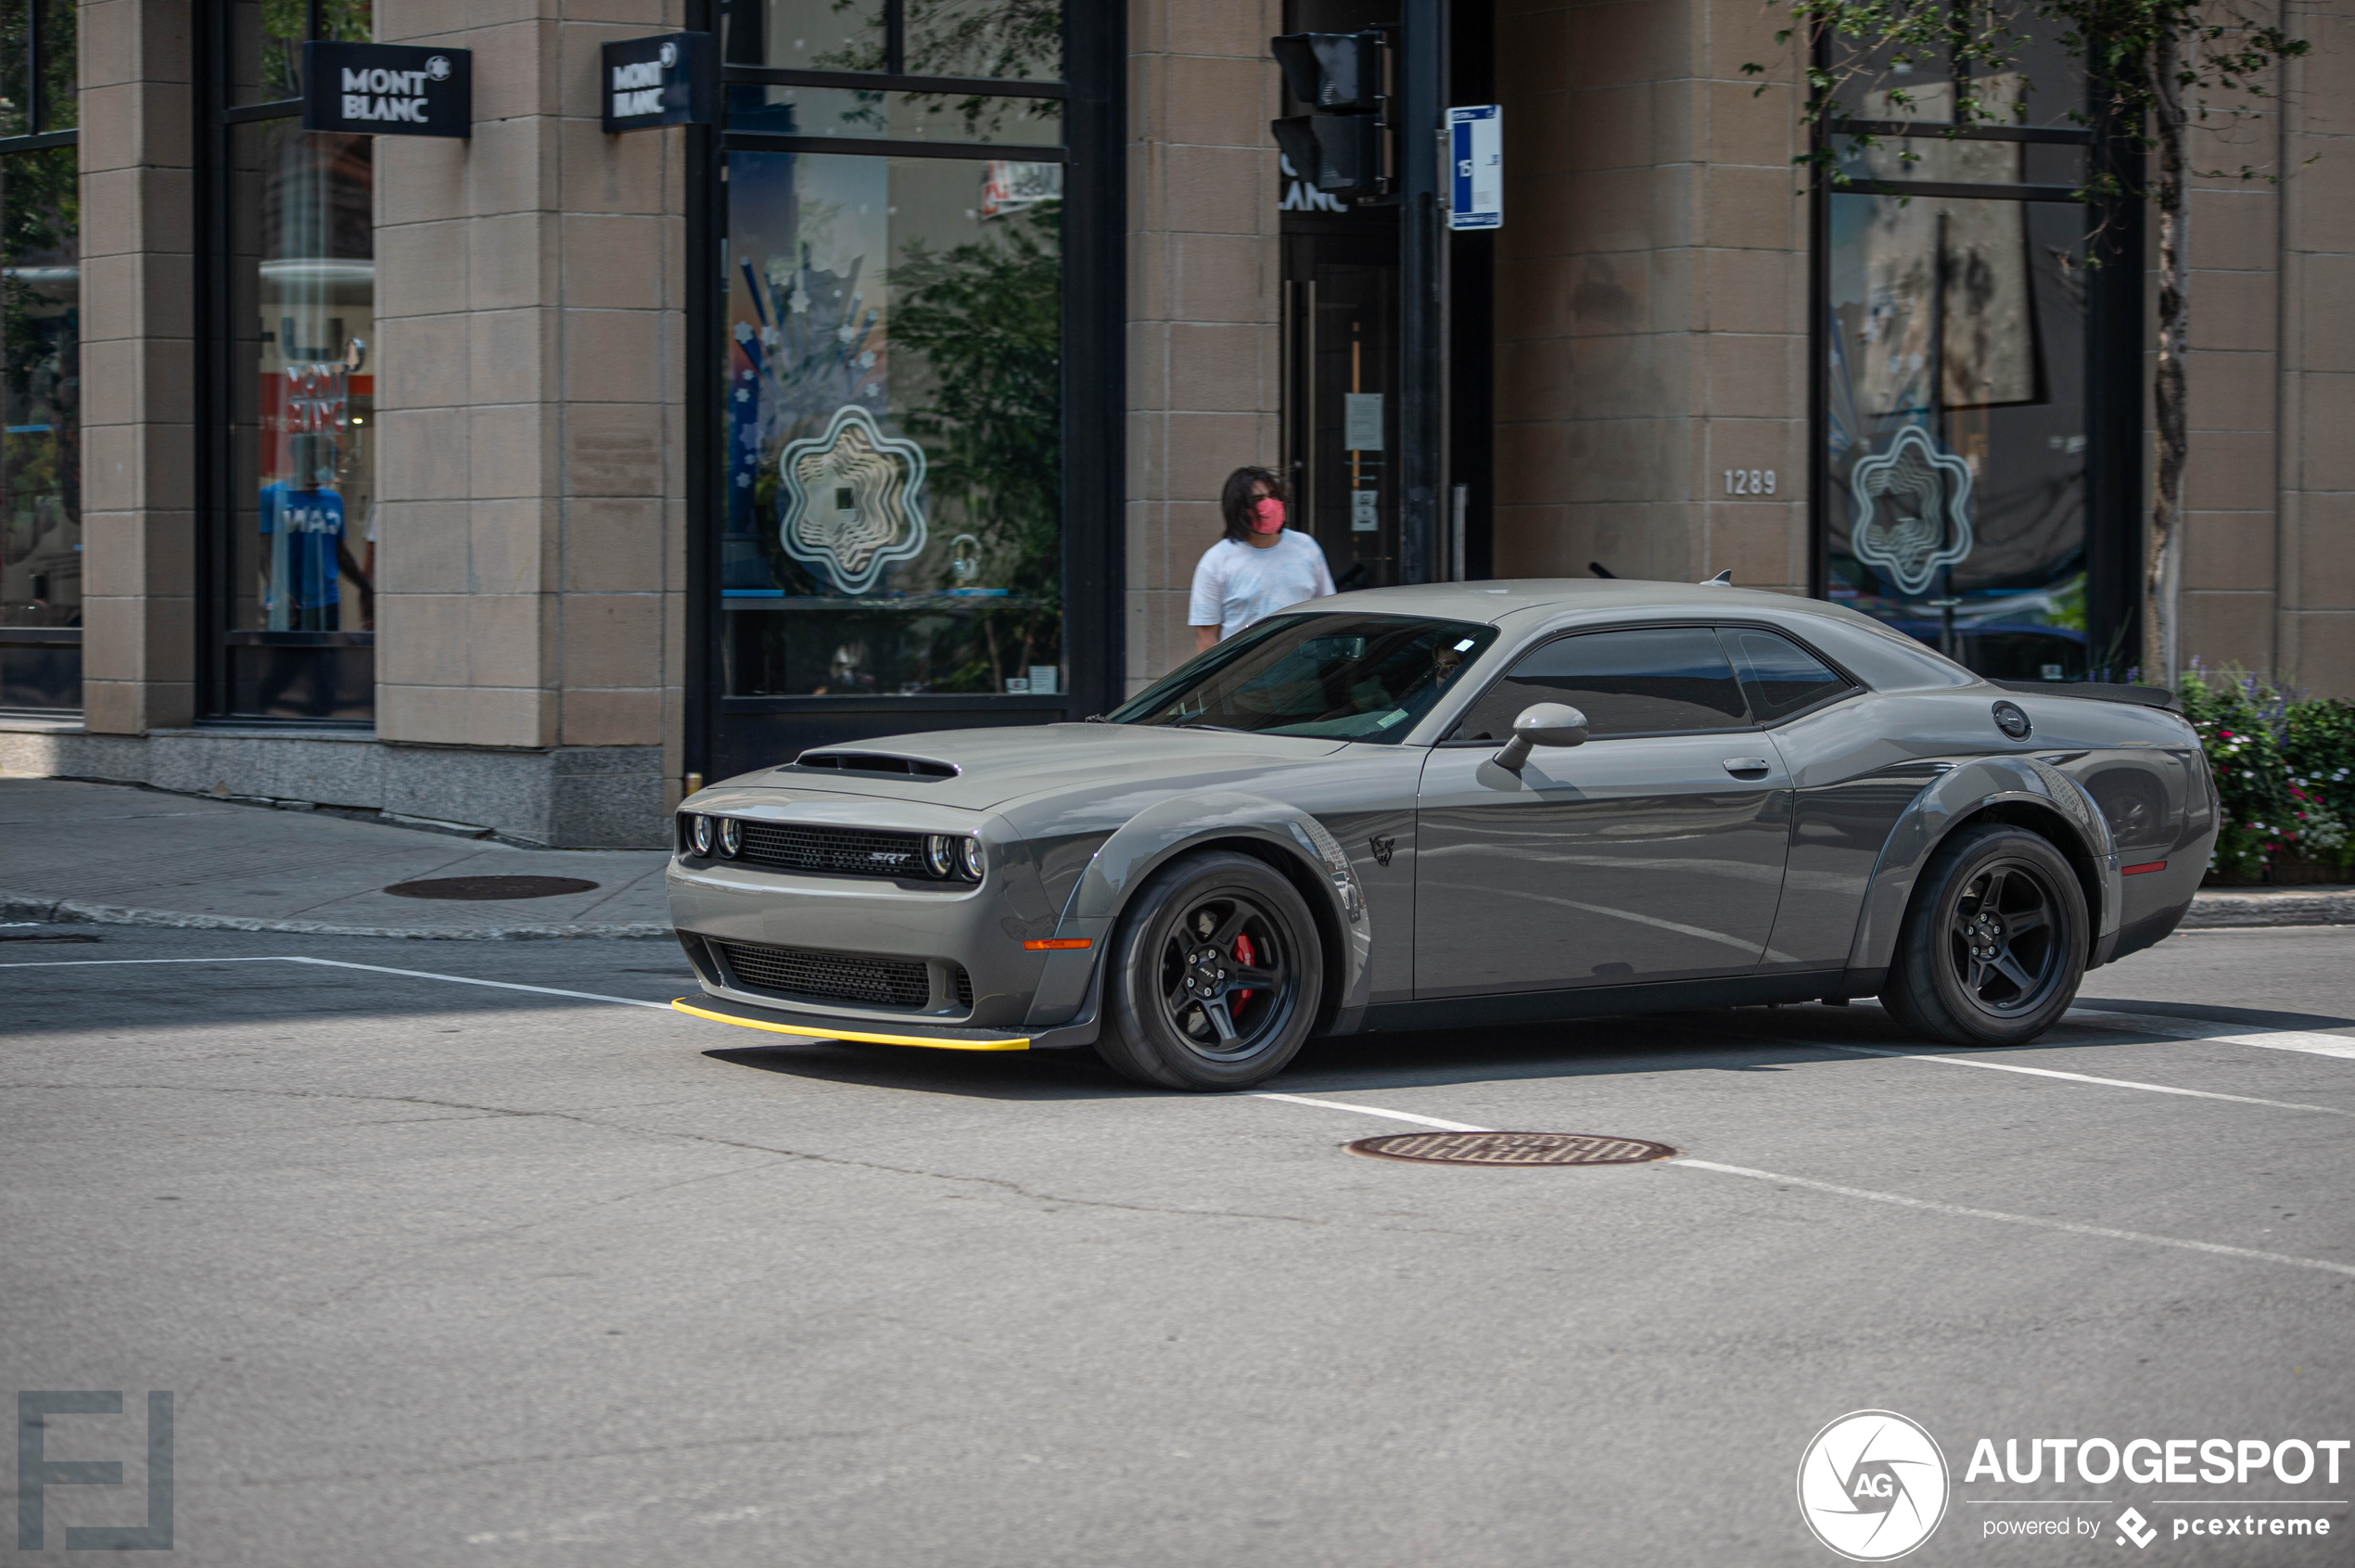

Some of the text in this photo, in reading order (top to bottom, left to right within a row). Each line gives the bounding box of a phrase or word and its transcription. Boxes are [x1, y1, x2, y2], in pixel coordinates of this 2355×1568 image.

[341, 67, 428, 96] MONT
[613, 60, 663, 91] MONT
[341, 95, 429, 123] BLANC
[613, 87, 665, 118] BLANC
[286, 362, 348, 398] MONT
[286, 400, 348, 435] BLANC
[1724, 469, 1776, 495] 1289
[869, 852, 911, 864] SRT
